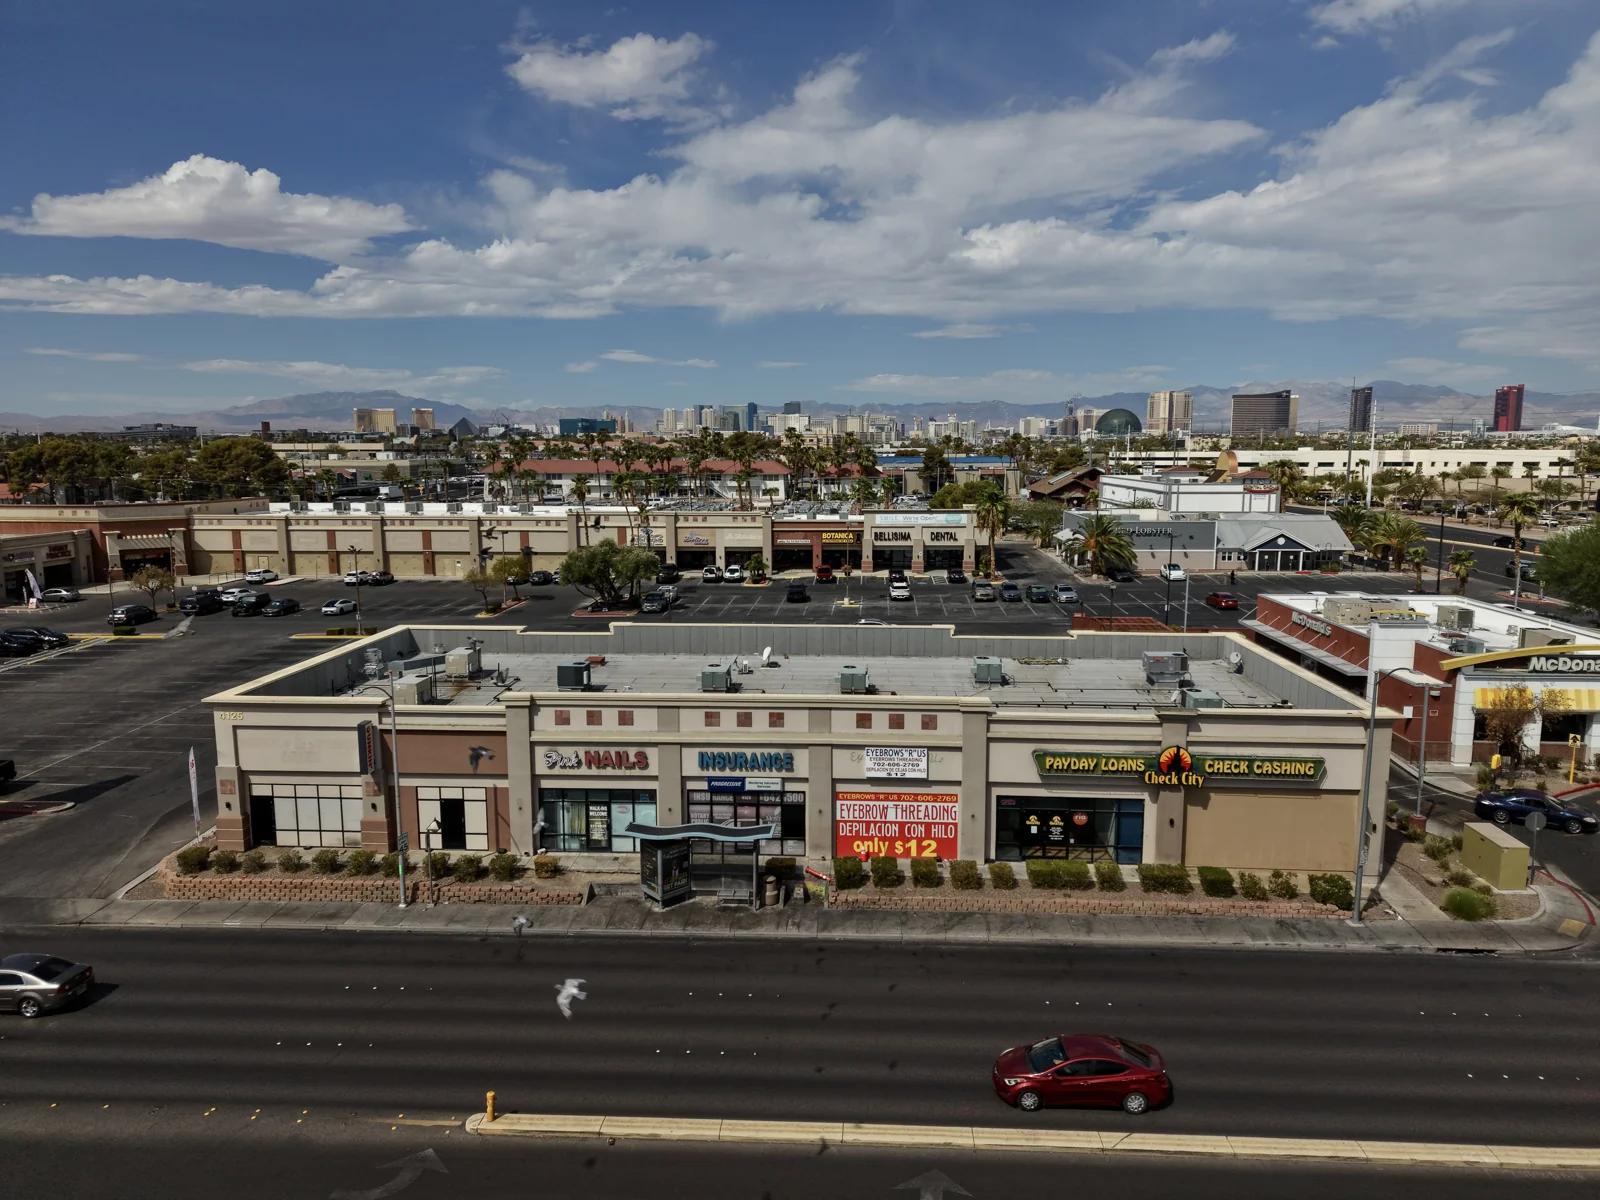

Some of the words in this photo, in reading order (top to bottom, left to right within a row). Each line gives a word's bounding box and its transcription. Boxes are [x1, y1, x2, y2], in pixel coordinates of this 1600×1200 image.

[874, 532, 911, 541] BELLISIMA
[931, 532, 958, 541] DENTAL
[1135, 526, 1172, 534] LOBSTER
[219, 711, 244, 720] 4125
[584, 750, 648, 768] NAILS
[866, 748, 904, 757] EYEBROWS
[917, 749, 926, 757] US
[698, 751, 793, 770] INSURANCE
[1045, 757, 1097, 770] PAYDAY
[1101, 758, 1145, 772] LOANS
[1205, 760, 1249, 773] CHECK
[1253, 761, 1315, 776] CASHING
[1145, 771, 1179, 785] Check
[1181, 771, 1205, 787] City
[900, 794, 957, 802] 702-606-2769
[840, 803, 889, 820] EYEBROW
[893, 804, 957, 821] THREADING
[839, 822, 899, 837] DEPILACION
[905, 823, 925, 838] CON
[931, 824, 955, 838] HILO
[853, 837, 889, 857] only
[894, 839, 938, 858] $12
